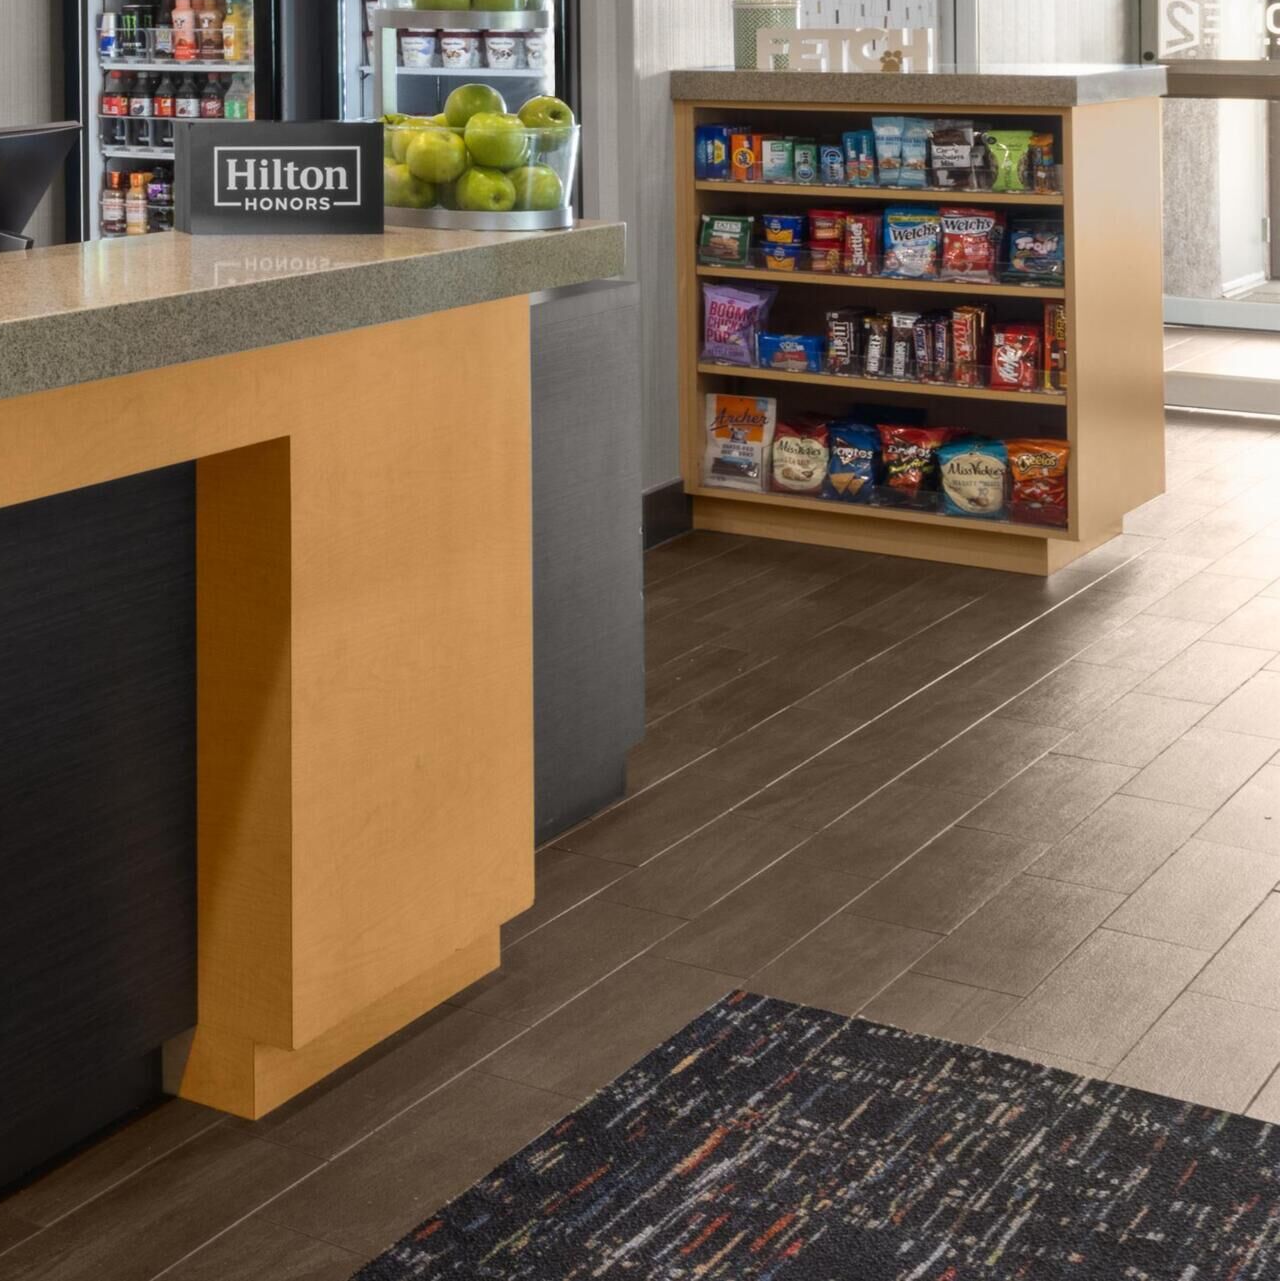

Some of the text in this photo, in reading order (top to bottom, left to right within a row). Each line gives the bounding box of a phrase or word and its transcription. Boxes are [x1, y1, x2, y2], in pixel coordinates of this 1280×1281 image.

[756, 27, 934, 73] FETCH
[226, 159, 349, 190] Hilton
[245, 197, 331, 211] HONORS
[893, 223, 938, 241] Welch's
[944, 218, 992, 233] Welch's
